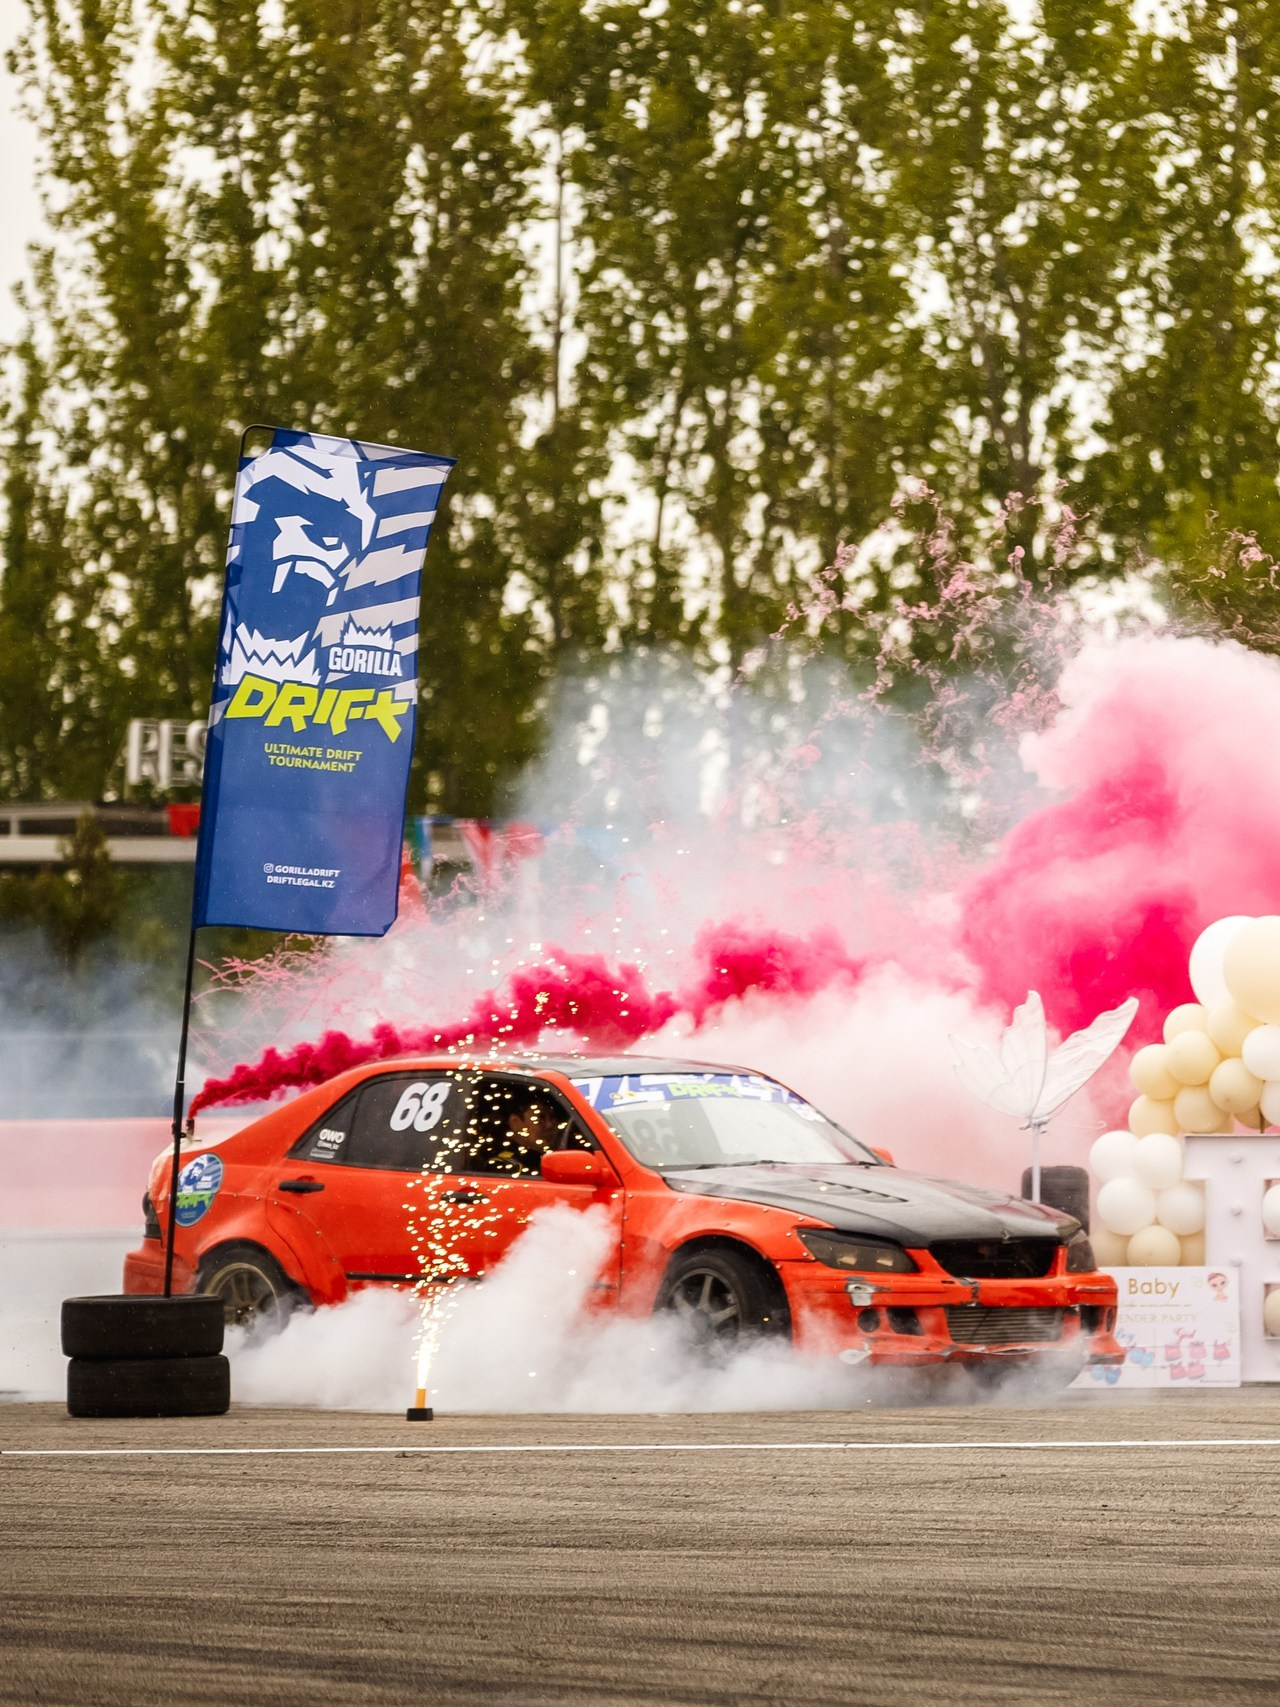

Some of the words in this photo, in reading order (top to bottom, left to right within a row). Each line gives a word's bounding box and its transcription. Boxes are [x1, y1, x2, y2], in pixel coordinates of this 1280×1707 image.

[328, 646, 402, 677] GORILLA
[224, 674, 410, 744] DRIFT
[264, 742, 323, 759] ULTIMATE
[326, 748, 362, 761] DRIFT
[268, 755, 356, 773] TOURNAMENT
[274, 865, 341, 877] GORILLADRIFT
[266, 875, 336, 889] DRIFTLEGAL.KZ
[390, 1082, 450, 1133] 68
[1128, 1278, 1180, 1299] Baby
[1118, 1313, 1158, 1324] ENDER
